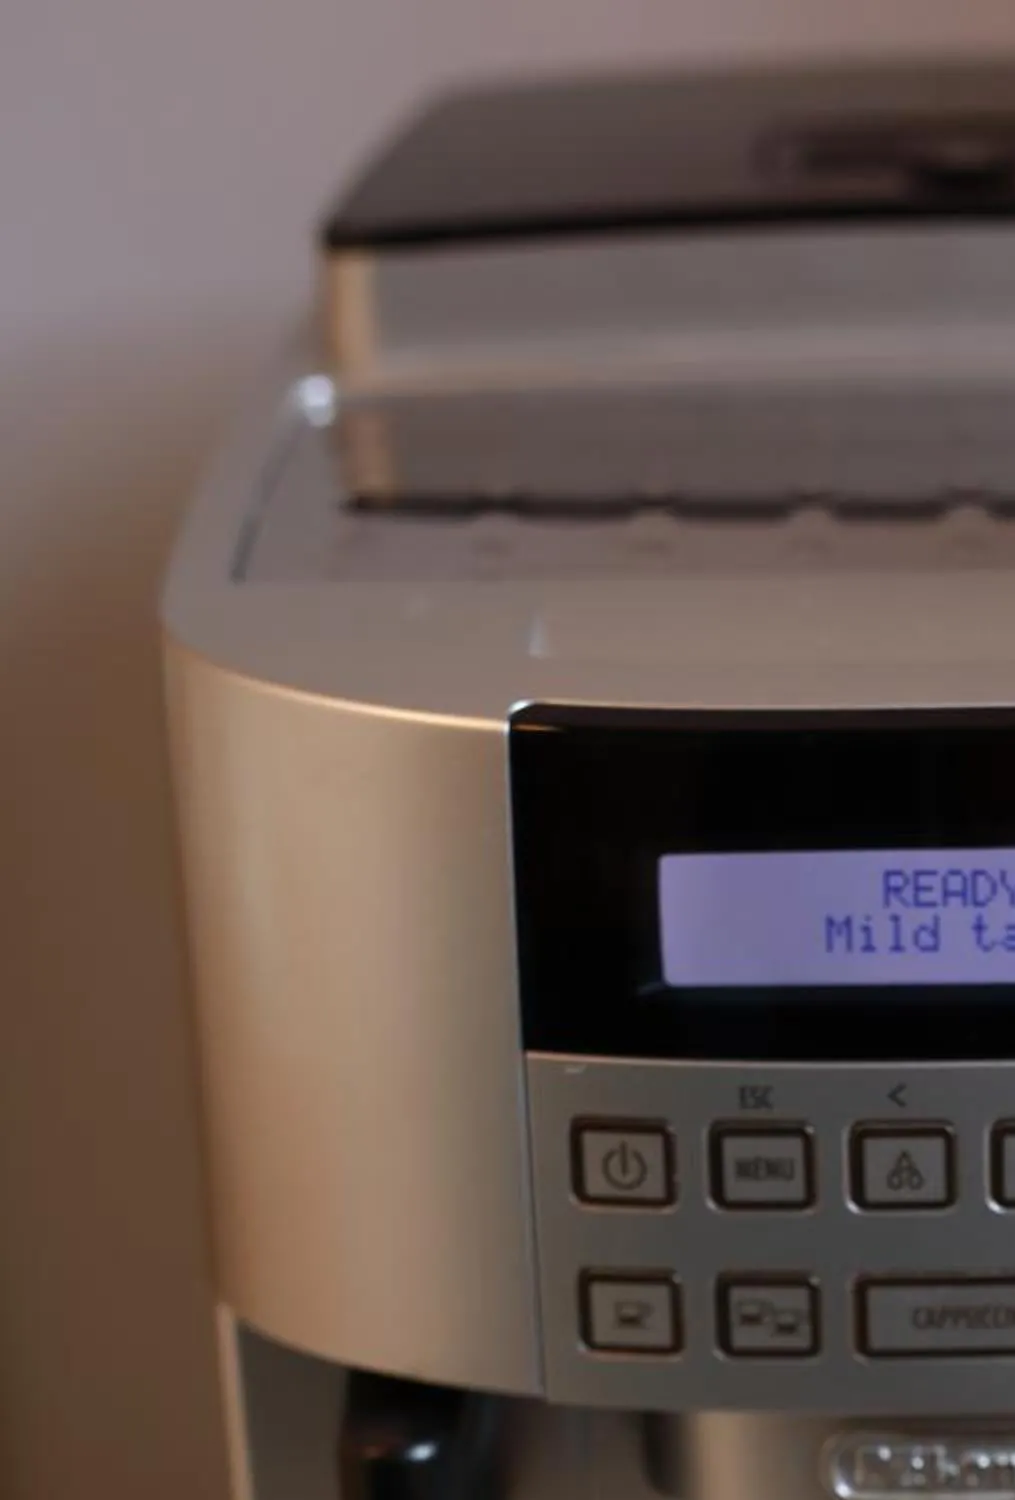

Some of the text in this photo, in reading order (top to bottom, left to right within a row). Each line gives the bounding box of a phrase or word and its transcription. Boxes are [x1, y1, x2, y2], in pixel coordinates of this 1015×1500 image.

[824, 915, 942, 954] Mild
[739, 1085, 774, 1109] ESC
[734, 1156, 796, 1182] MENU
